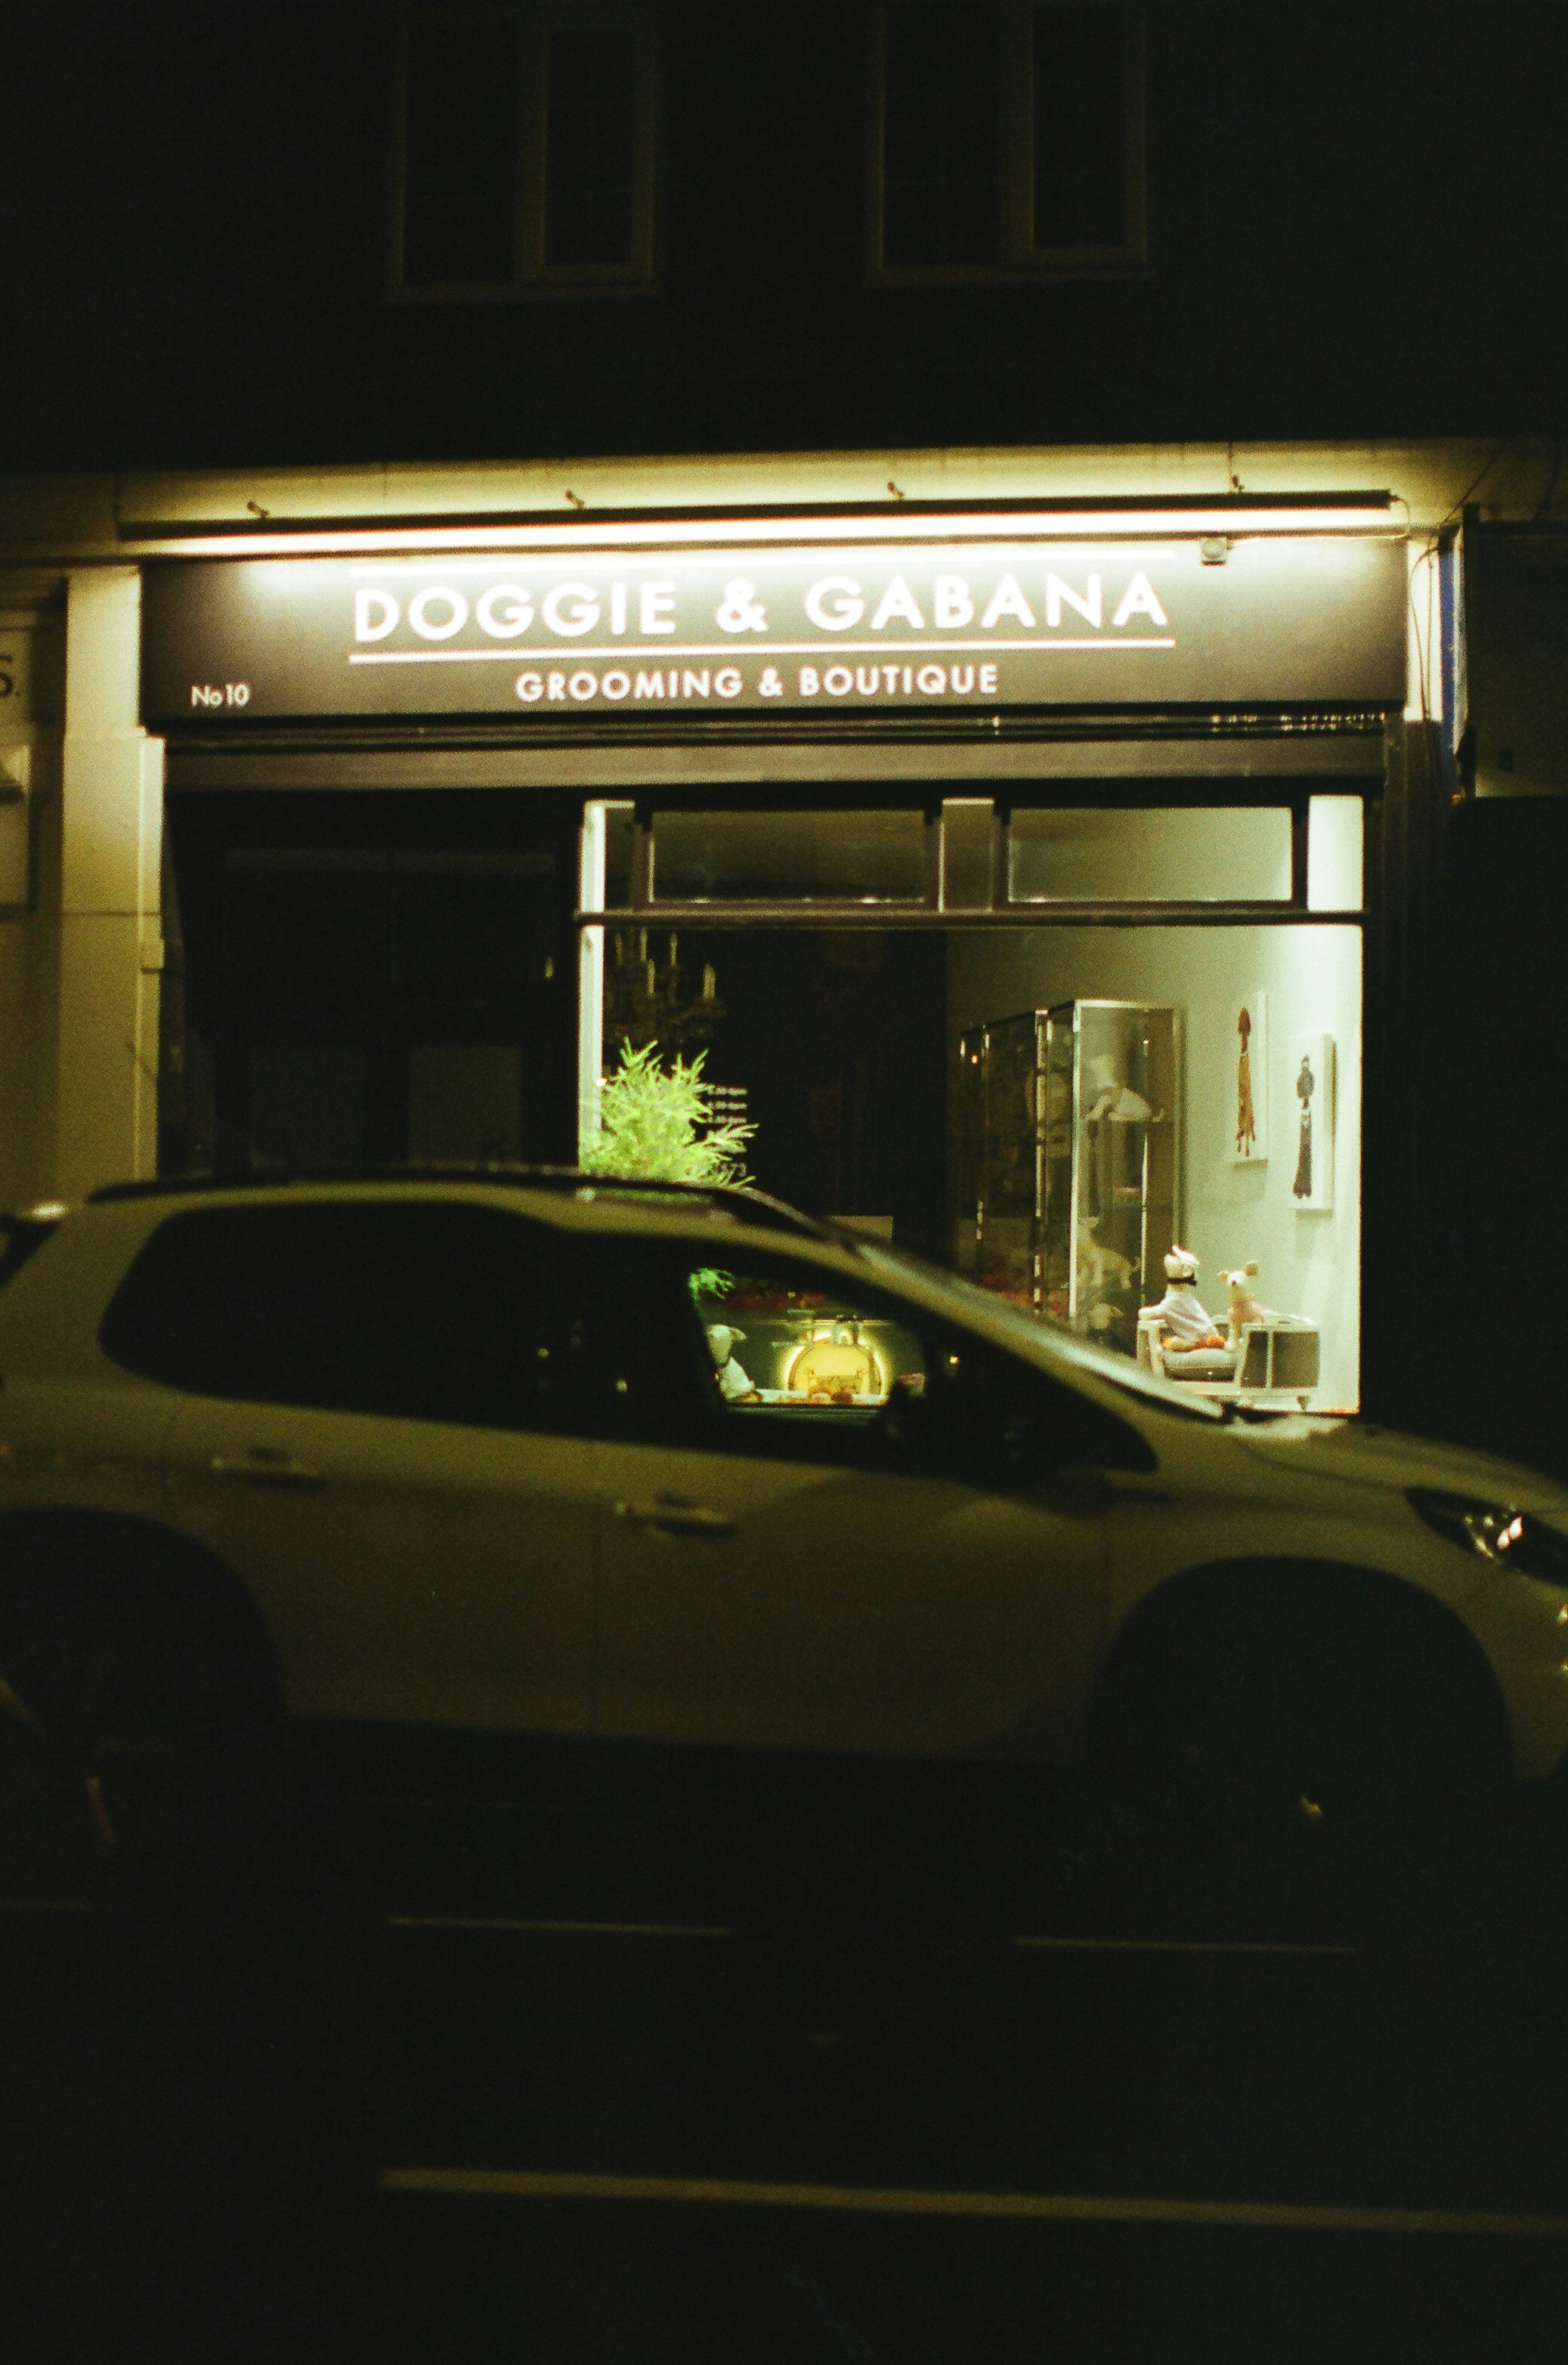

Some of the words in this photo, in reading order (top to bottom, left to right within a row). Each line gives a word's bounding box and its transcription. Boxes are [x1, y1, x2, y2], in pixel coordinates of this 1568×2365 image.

[354, 582, 677, 642] DOGGIE
[715, 579, 769, 633] &
[803, 572, 1168, 632] GABANA
[515, 668, 744, 702] GROOMING
[758, 666, 784, 697] &
[798, 664, 998, 697] BOUTIQUE
